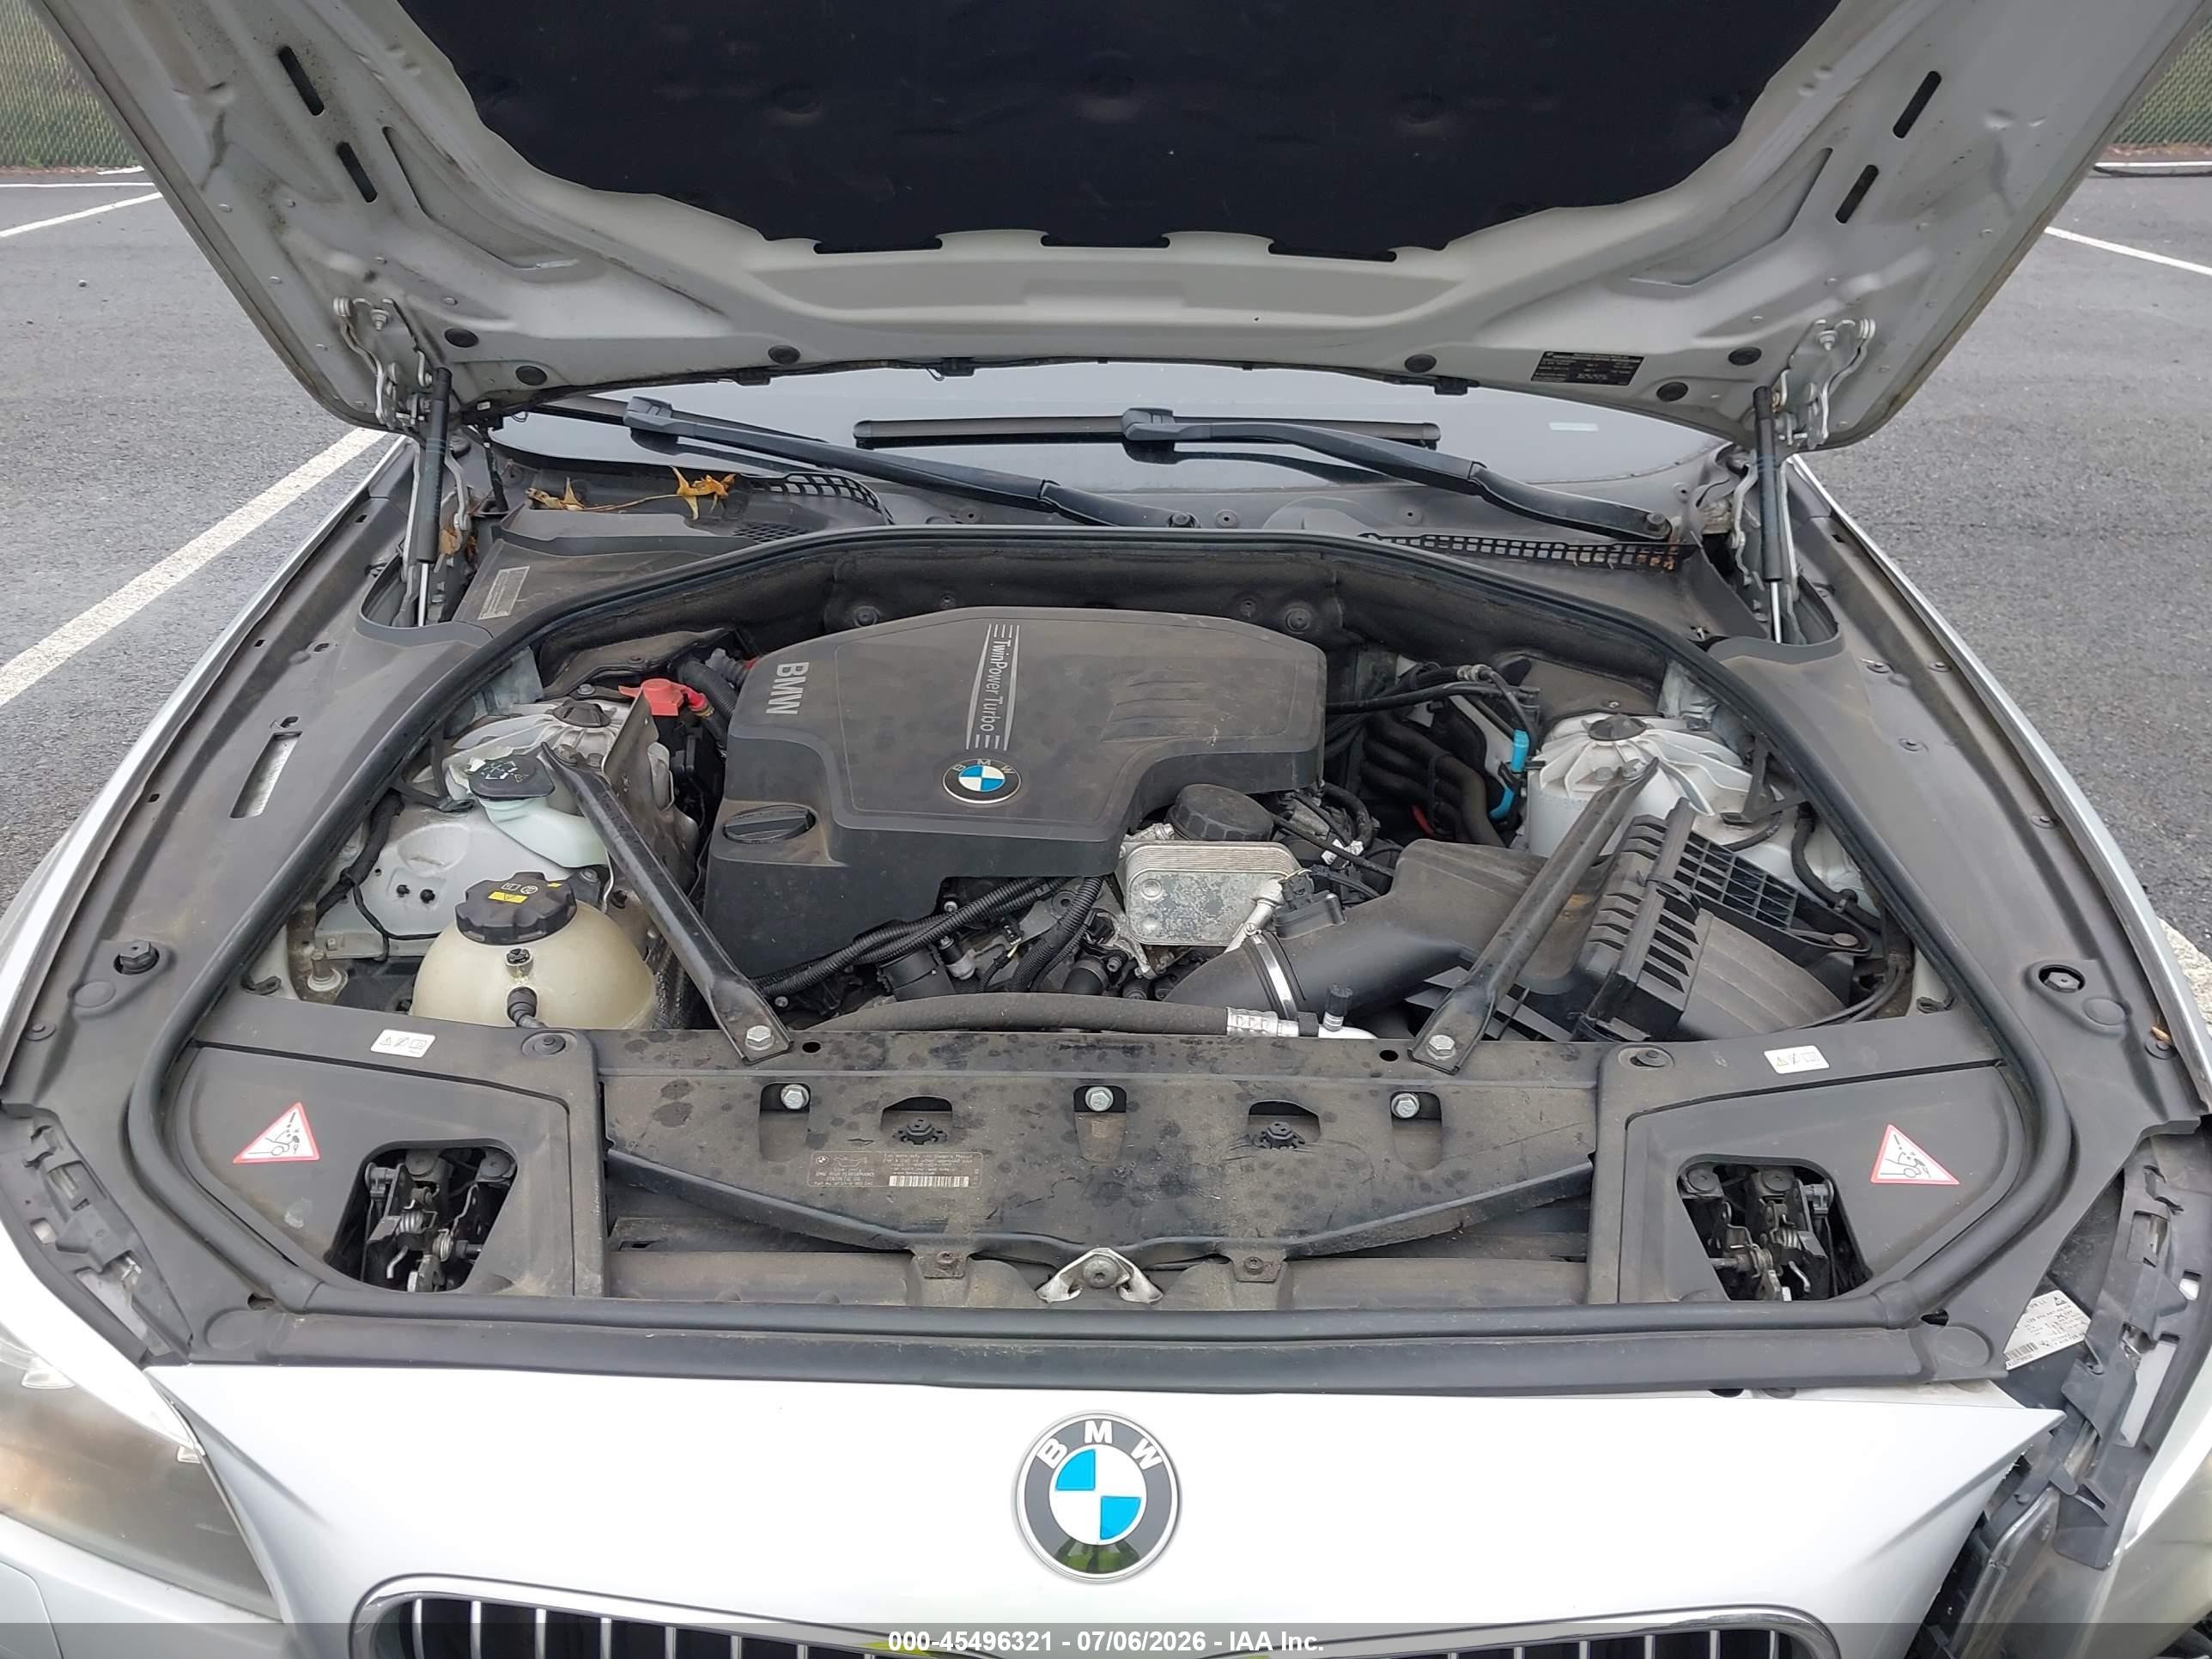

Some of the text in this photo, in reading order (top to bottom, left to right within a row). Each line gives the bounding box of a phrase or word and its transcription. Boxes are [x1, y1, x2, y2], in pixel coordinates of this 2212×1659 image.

[766, 661, 810, 714] BMW
[980, 639, 1012, 732] TwinPower Turbo
[952, 758, 1015, 774] BMW
[1036, 1419, 1164, 1470] BMW
